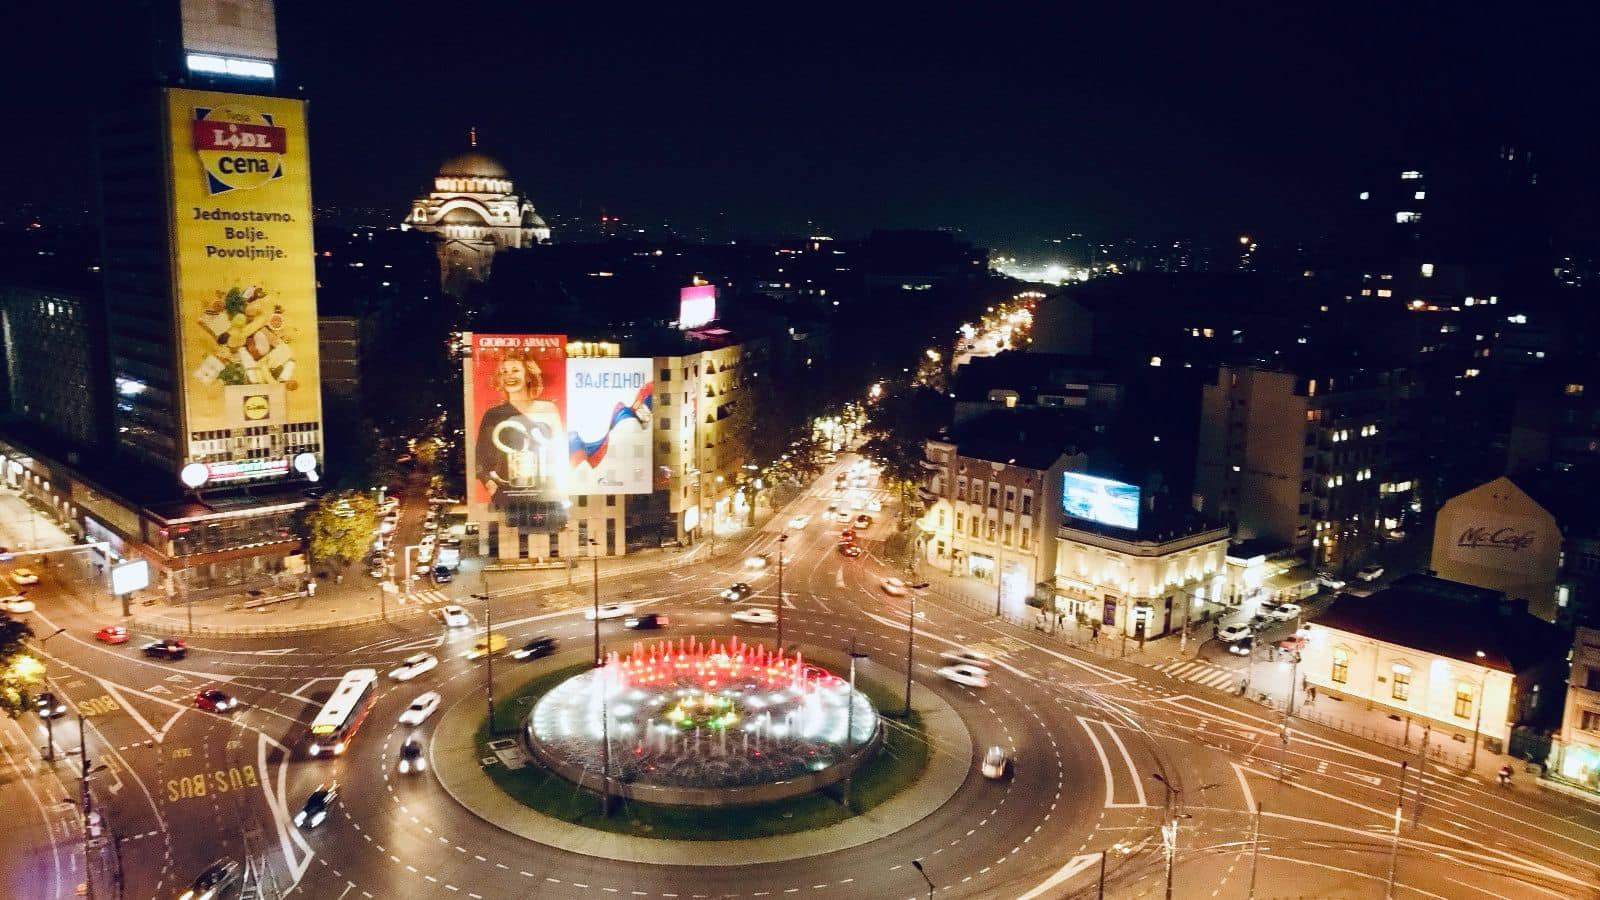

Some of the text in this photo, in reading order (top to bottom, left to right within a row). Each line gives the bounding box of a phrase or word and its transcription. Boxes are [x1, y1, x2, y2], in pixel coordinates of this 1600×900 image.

[218, 156, 269, 174] cena
[192, 207, 295, 222] Jednostavno.
[224, 227, 269, 242] Bolje.
[205, 245, 288, 261] Povoljnije.
[479, 337, 560, 347] GIORGIO ARMANI
[78, 695, 120, 717] BUS
[215, 765, 258, 793] BUS
[167, 774, 206, 802] BUS
